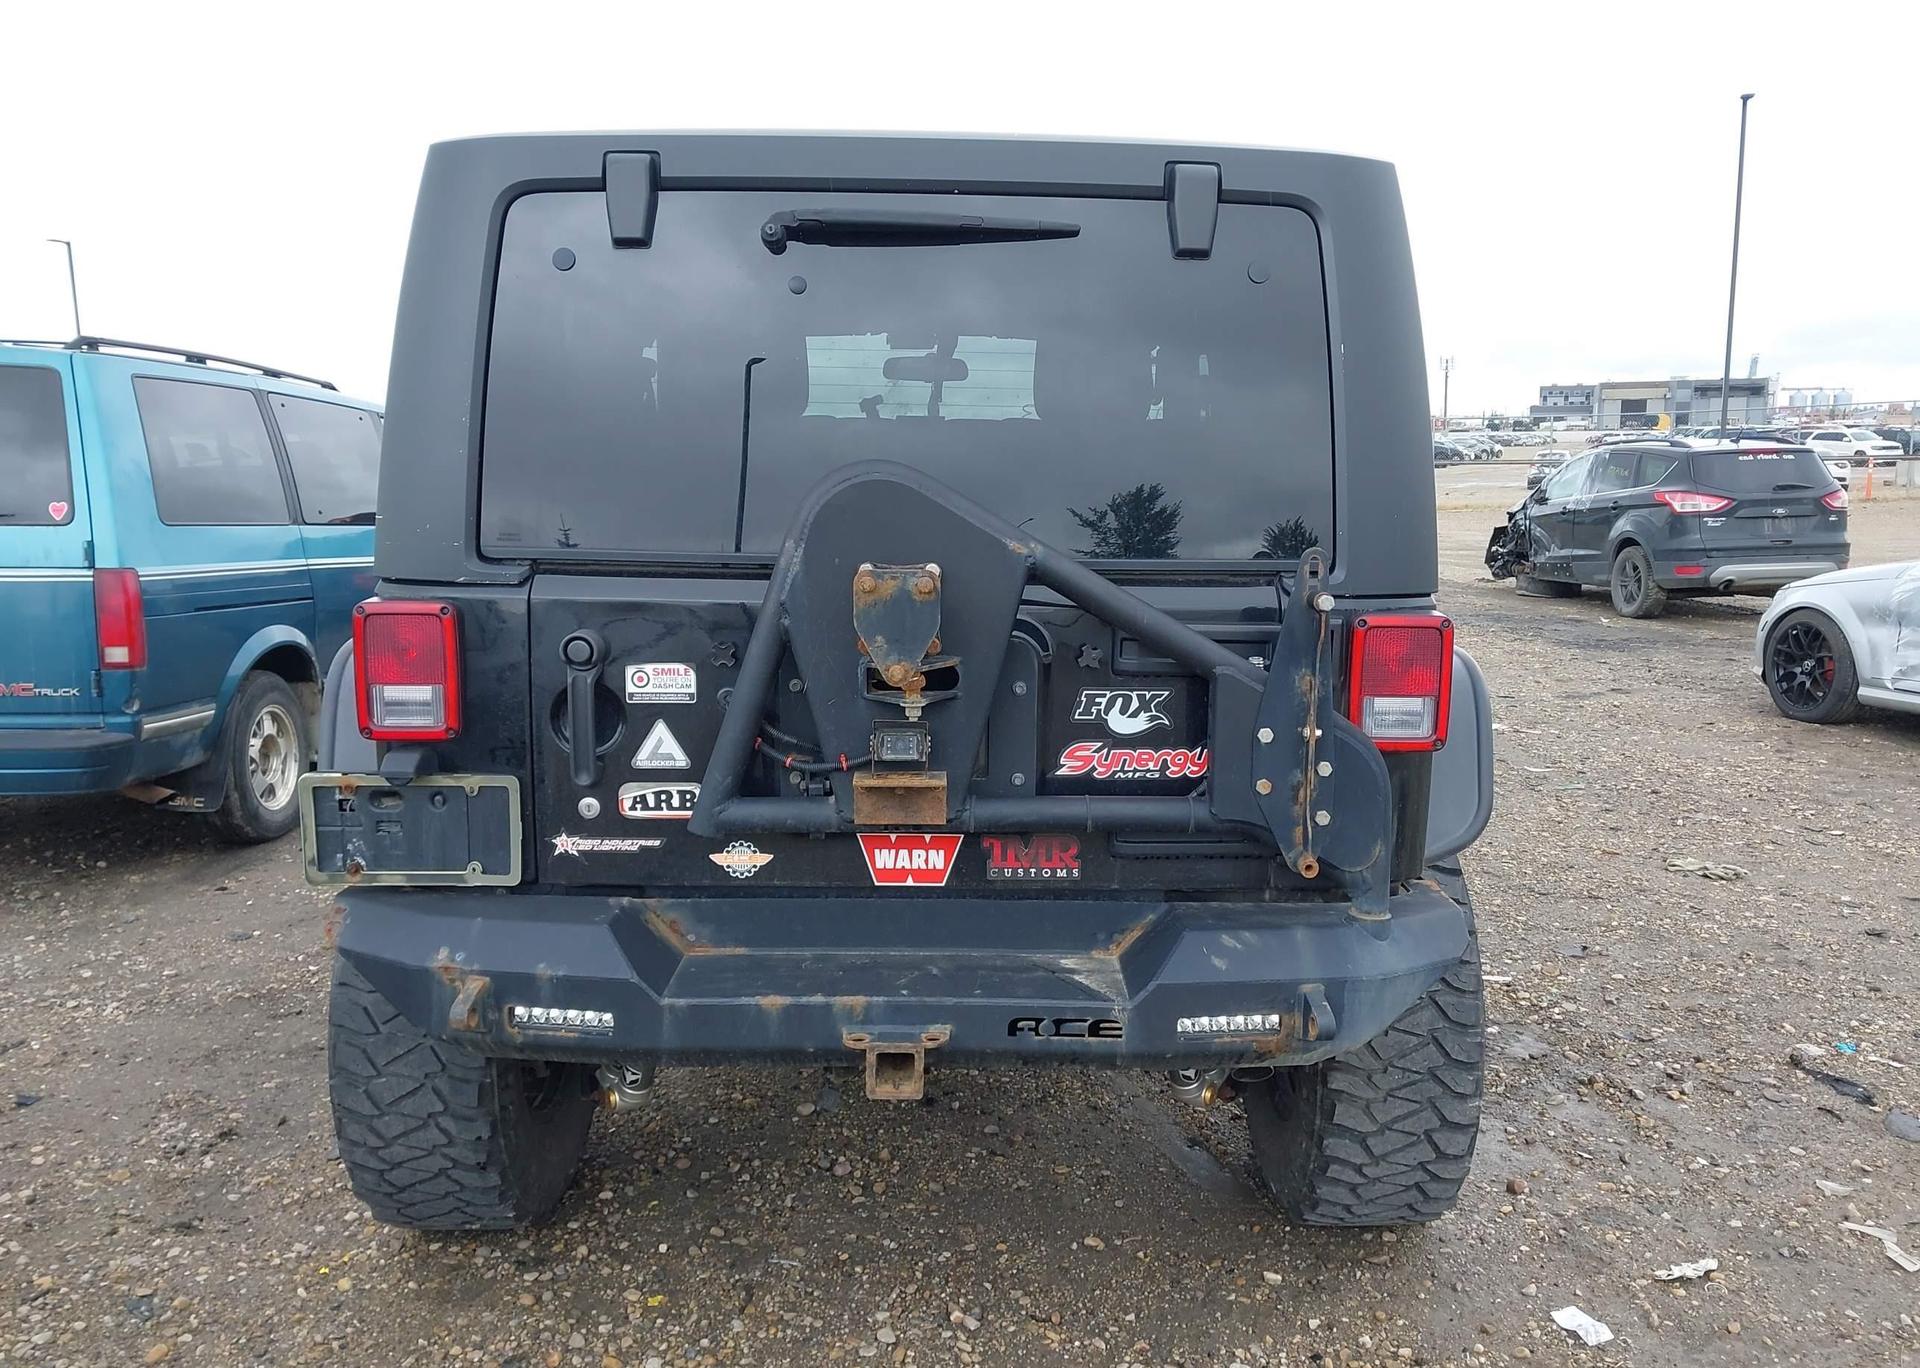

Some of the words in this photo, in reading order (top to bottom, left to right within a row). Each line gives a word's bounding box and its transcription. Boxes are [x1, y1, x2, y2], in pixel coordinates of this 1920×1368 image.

[652, 668, 692, 676] SMILE
[0, 683, 34, 697] MC
[33, 688, 80, 696] TRUCK
[1074, 690, 1170, 728] FOX
[1055, 743, 1209, 779] Synergy
[1114, 771, 1161, 779] MFG
[628, 790, 697, 811] ARB
[874, 848, 945, 870] WARN
[990, 868, 1080, 878] CUSTOMS
[1007, 1017, 1123, 1038] ACE
